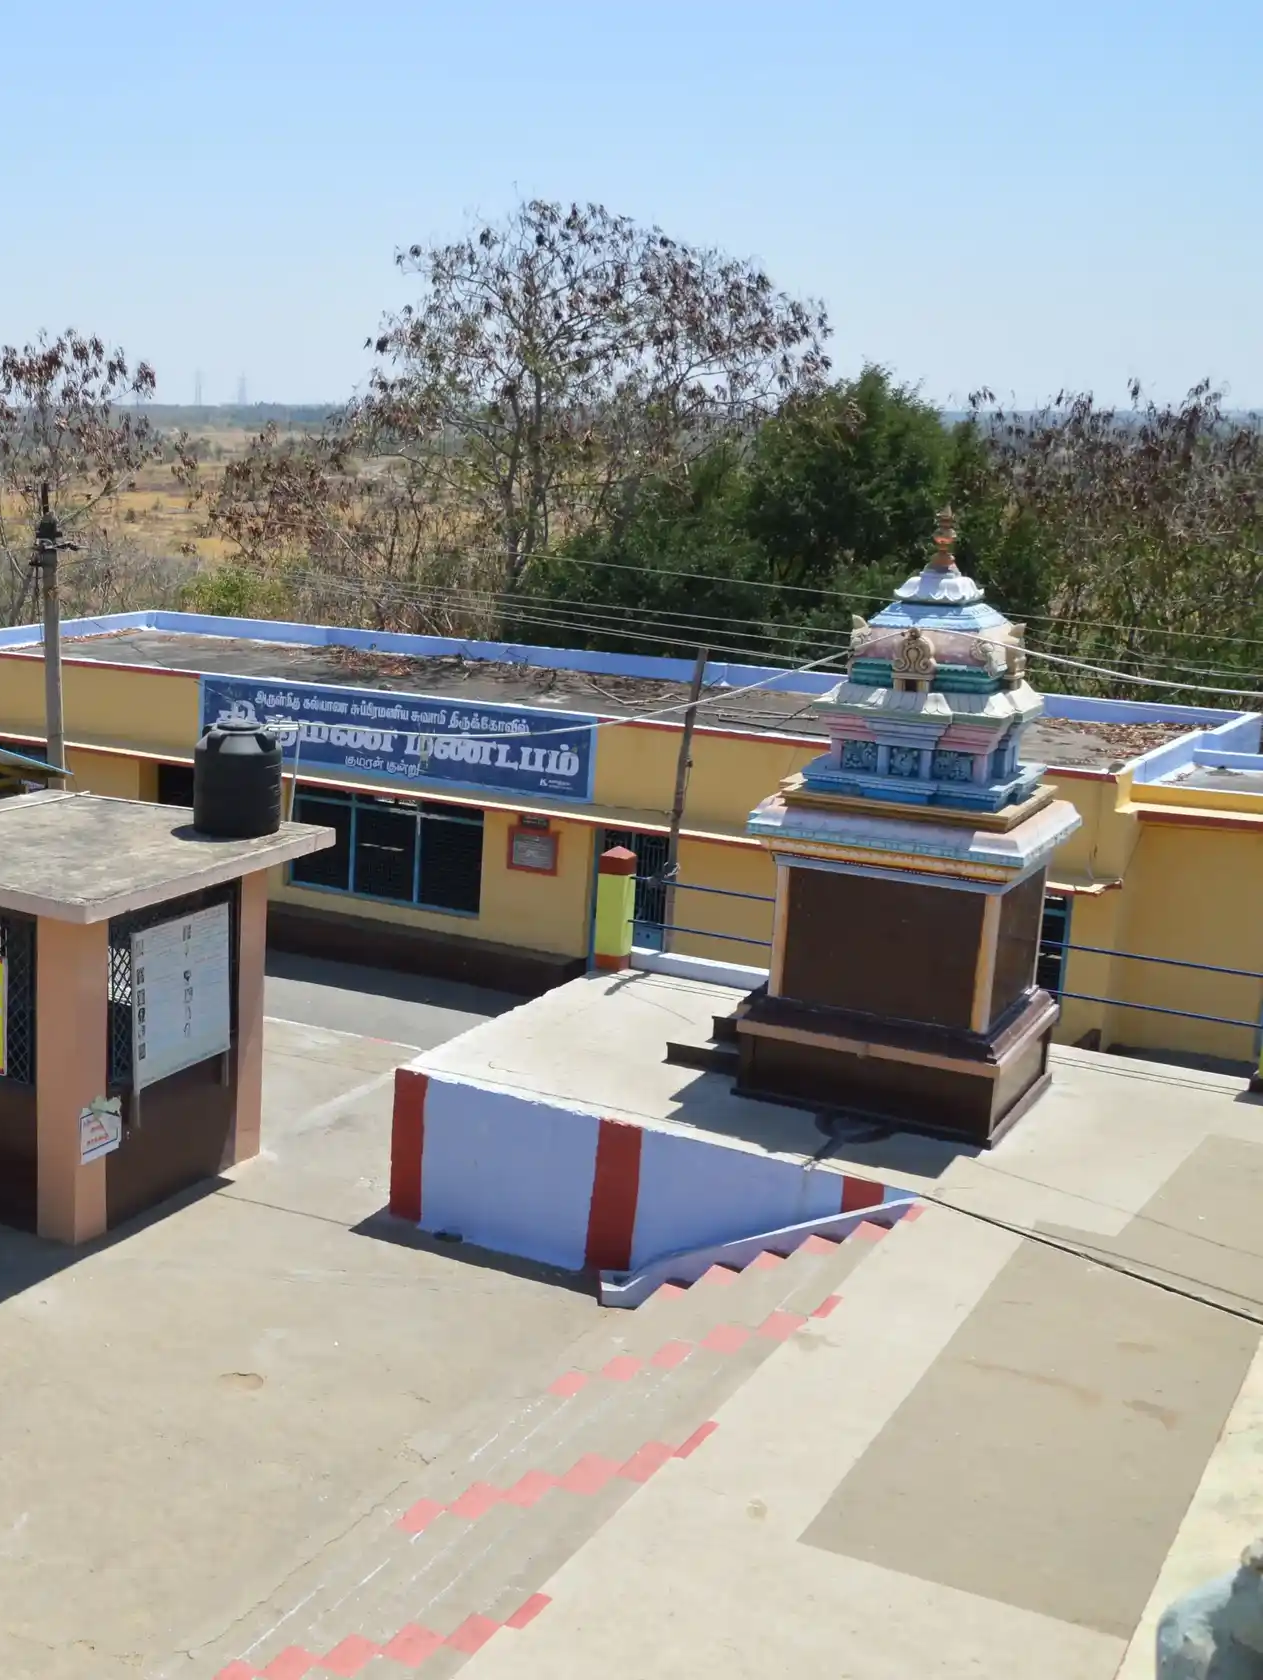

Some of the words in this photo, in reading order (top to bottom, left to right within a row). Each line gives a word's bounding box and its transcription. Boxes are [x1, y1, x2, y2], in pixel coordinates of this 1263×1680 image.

[303, 696, 348, 714] கல்யாண
[345, 756, 384, 770] குமரன்
[404, 731, 580, 777] மண்டபம்
